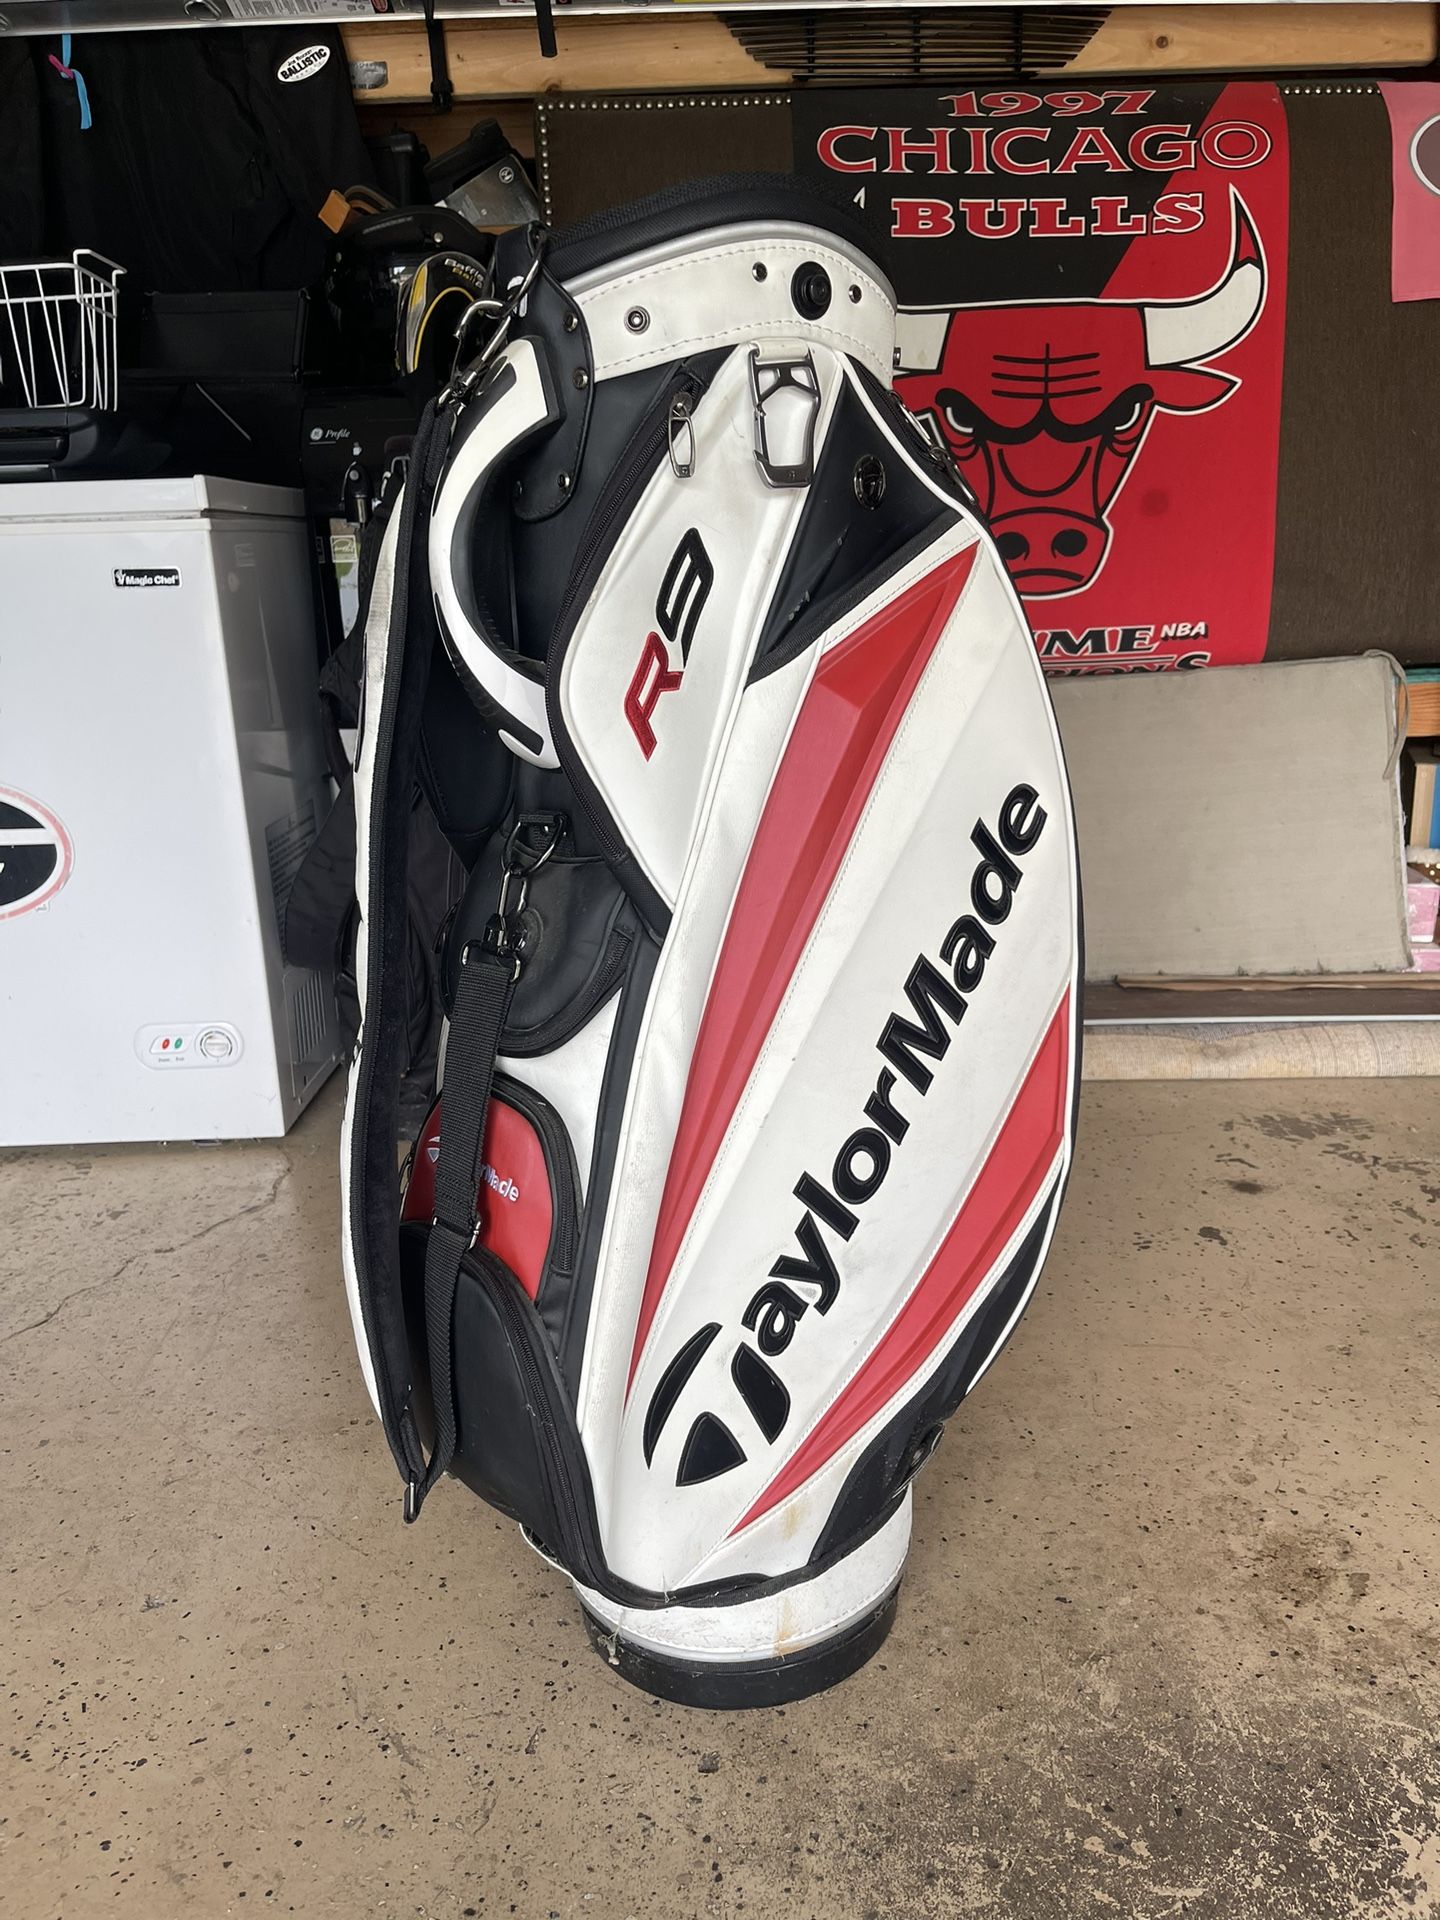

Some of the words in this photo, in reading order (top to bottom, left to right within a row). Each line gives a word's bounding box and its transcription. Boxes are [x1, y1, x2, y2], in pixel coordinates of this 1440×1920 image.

[280, 48, 327, 80] BALLISTIC
[938, 90, 1157, 117] 1997
[816, 119, 1273, 176] CHICAGO
[890, 192, 1206, 239] BULLS
[125, 574, 154, 586] Magic
[623, 527, 714, 762] R9
[1160, 621, 1209, 641] NBA
[643, 782, 1049, 1488] TaylorMade
